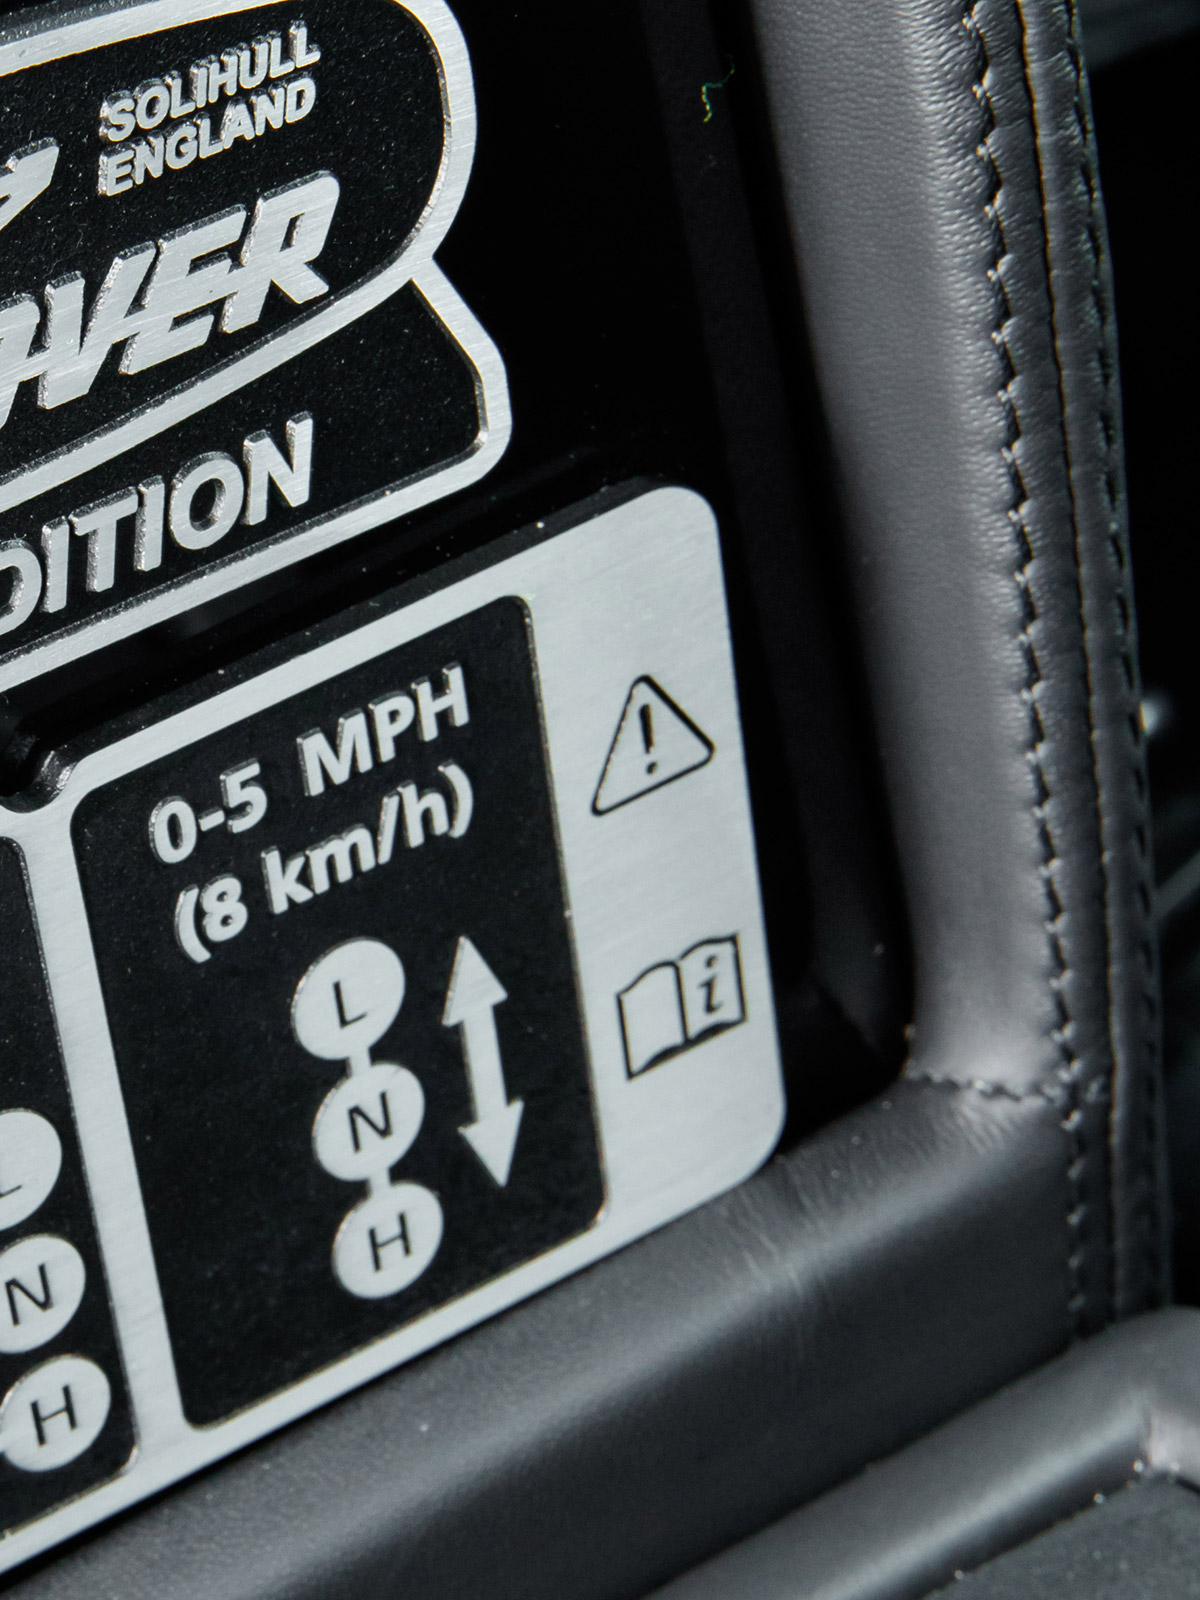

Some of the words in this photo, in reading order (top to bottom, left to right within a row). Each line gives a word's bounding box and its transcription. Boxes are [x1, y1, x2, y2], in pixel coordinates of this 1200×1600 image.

[100, 20, 320, 141] SOLIHULL
[96, 76, 317, 196] ENGLAND
[148, 757, 269, 864] 0-5
[296, 662, 471, 797] MPH
[173, 874, 248, 963] (8
[261, 761, 474, 915] km/h)
[333, 979, 367, 1029] L
[349, 1091, 392, 1154] N
[367, 1211, 411, 1273] H
[4, 1263, 52, 1327] N
[30, 1384, 78, 1447] H
